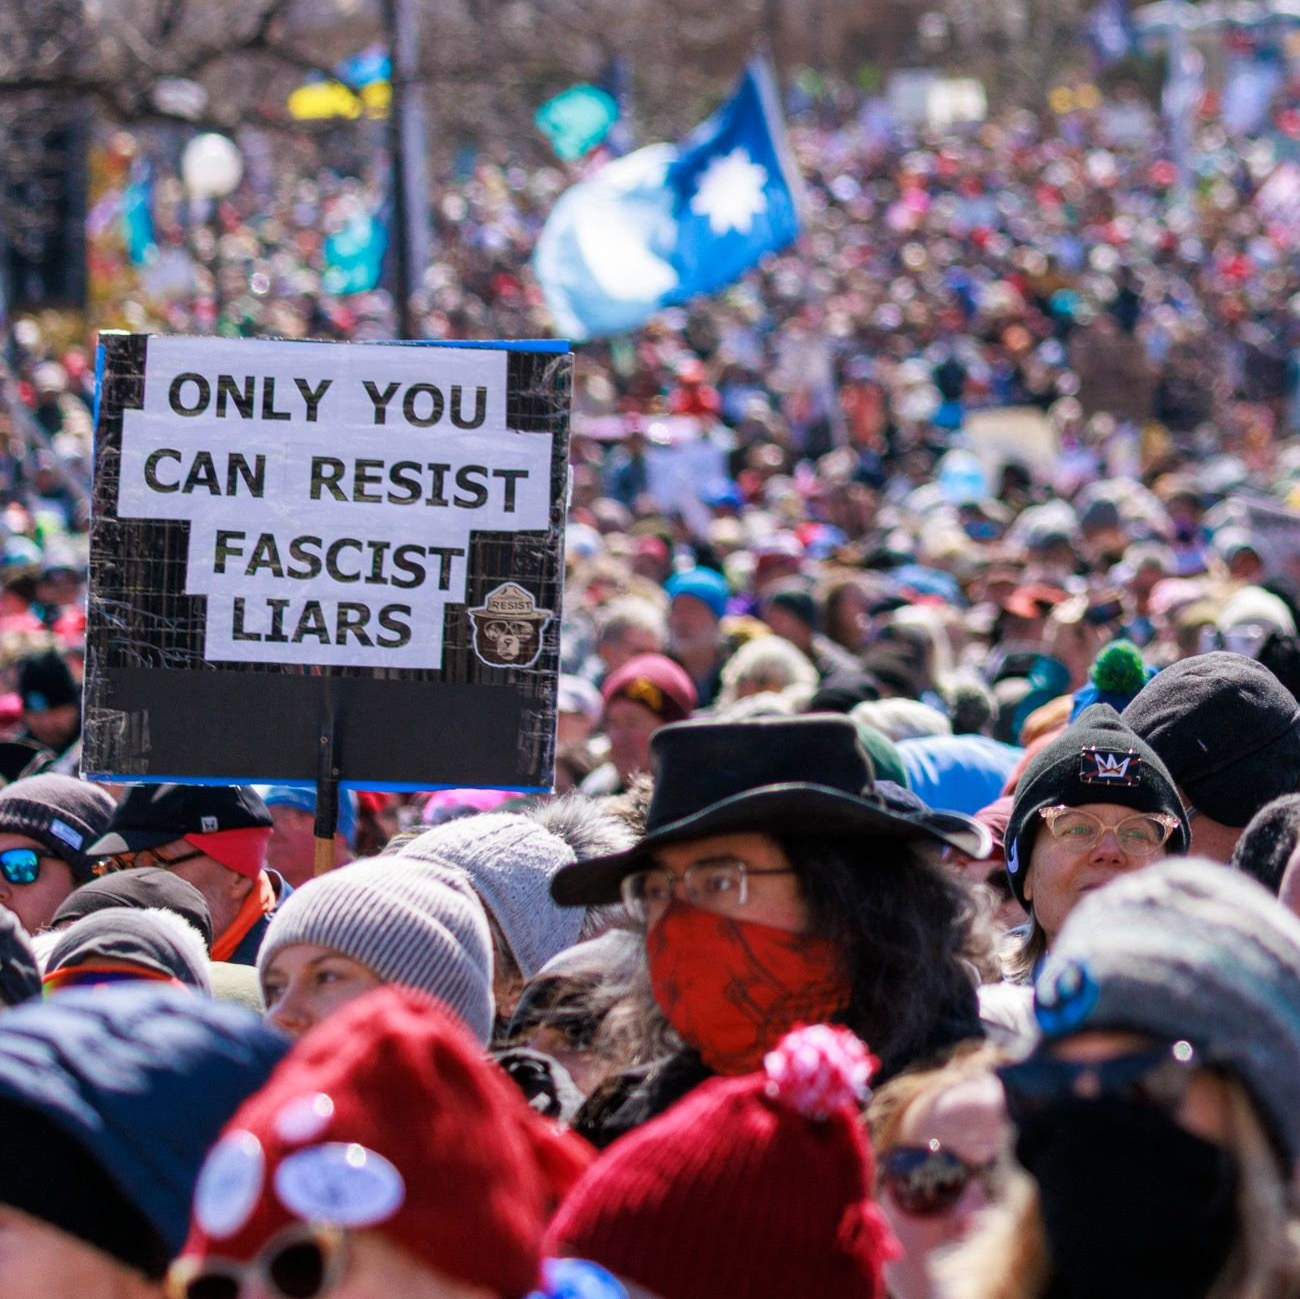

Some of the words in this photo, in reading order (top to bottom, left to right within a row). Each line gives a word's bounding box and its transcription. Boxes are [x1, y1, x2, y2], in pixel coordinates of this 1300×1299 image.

[167, 372, 333, 422] ONLY
[362, 380, 488, 430] YOU
[143, 448, 267, 498] CAN
[309, 456, 530, 513] RESIST
[213, 530, 465, 591] FASCIST
[231, 597, 413, 649] LIARS
[492, 600, 532, 610] RESIST
